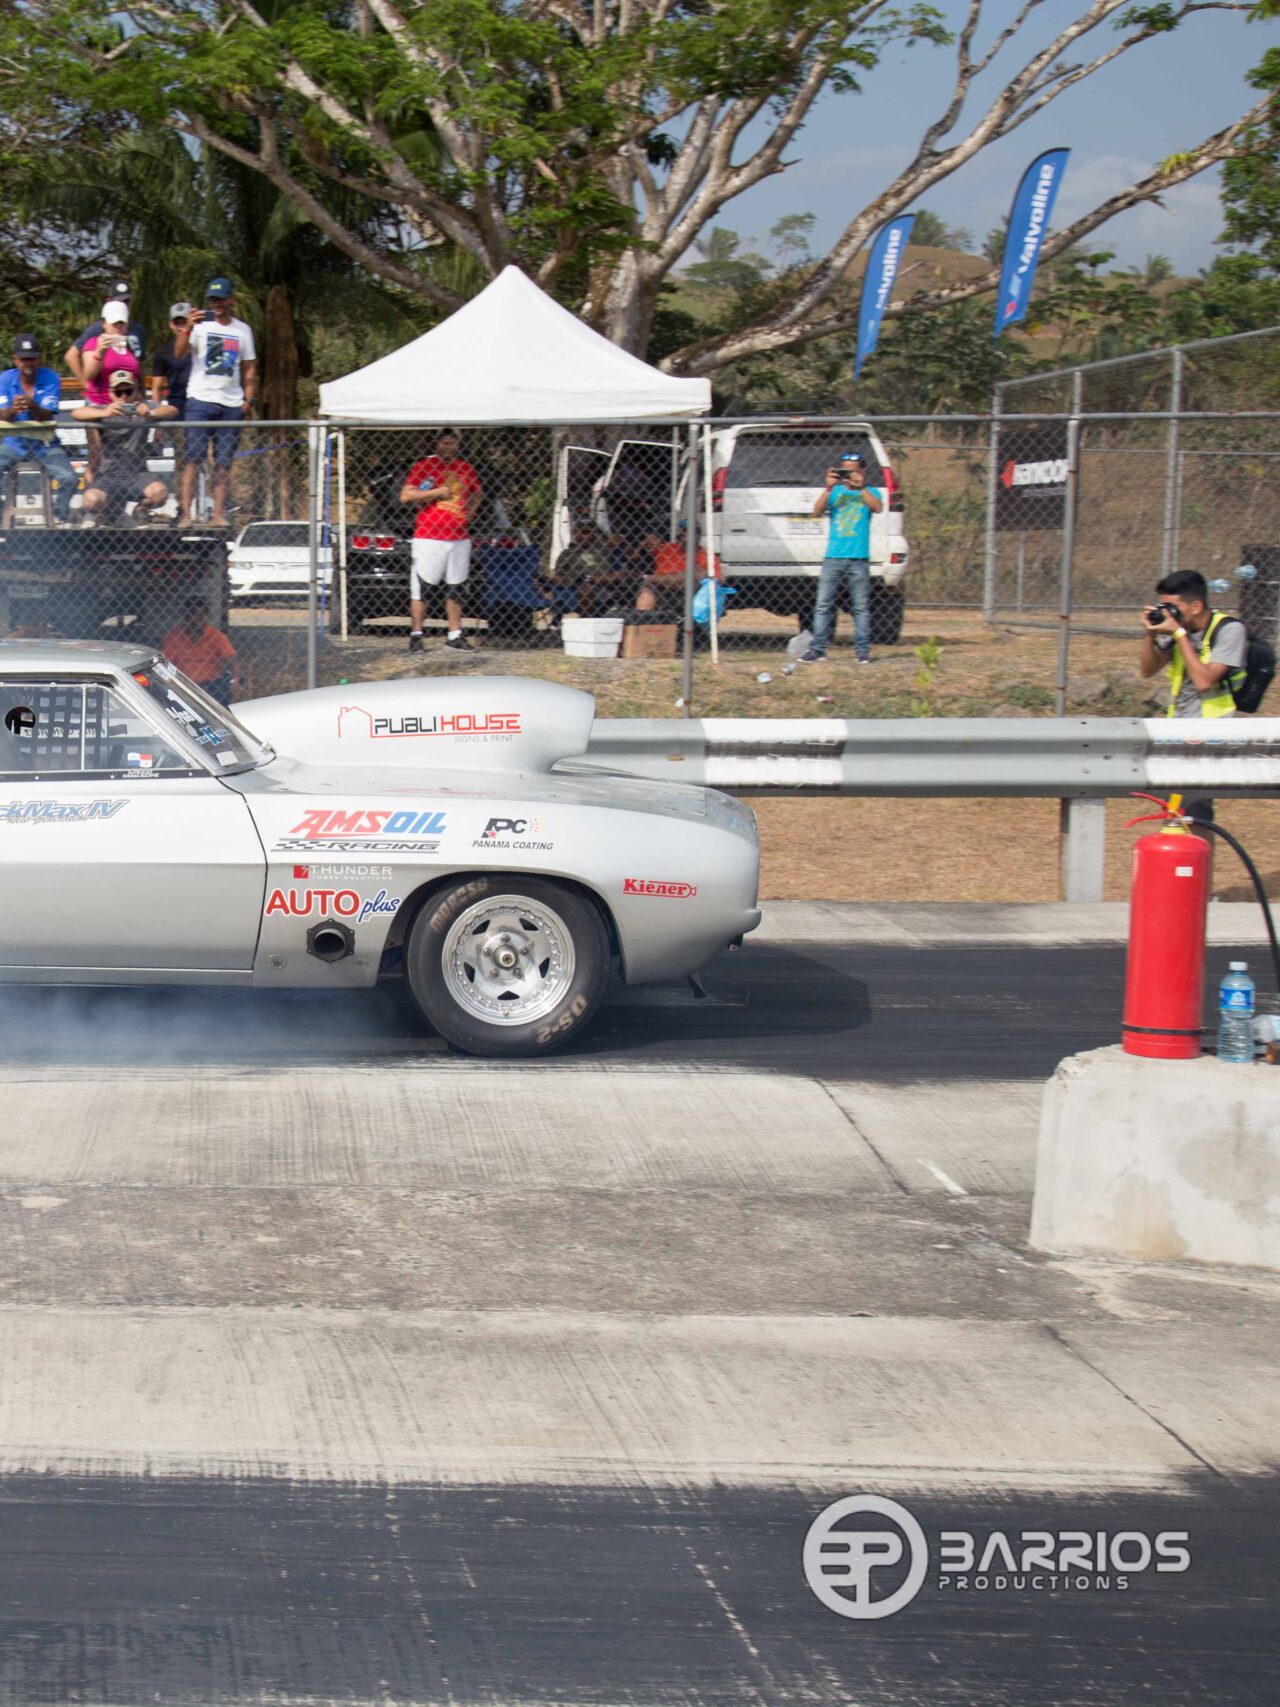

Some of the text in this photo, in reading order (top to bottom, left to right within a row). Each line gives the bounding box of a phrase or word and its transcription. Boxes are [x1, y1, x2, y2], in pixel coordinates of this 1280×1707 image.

[374, 713, 521, 735] PUBLI HOUSE
[288, 810, 447, 839] AMSOIL
[326, 842, 439, 851] RACING
[472, 840, 554, 850] PANAMA COATING
[309, 865, 393, 875] THUNDER
[623, 879, 687, 896] Kiener
[266, 890, 400, 923] AUTO plus
